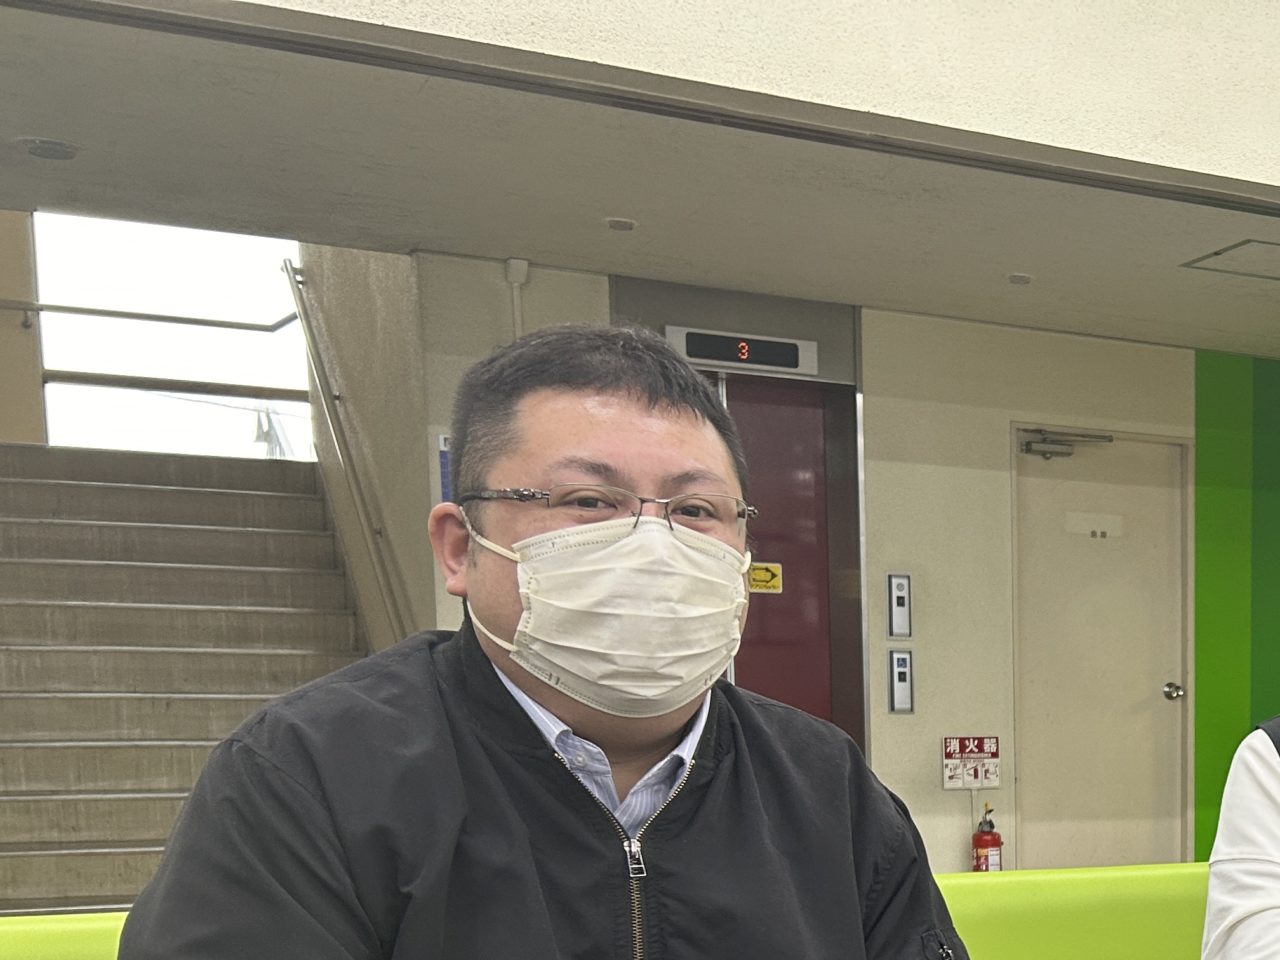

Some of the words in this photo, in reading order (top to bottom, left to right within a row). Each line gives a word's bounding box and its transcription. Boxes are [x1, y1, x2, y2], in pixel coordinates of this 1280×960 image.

[738, 341, 750, 360] 3
[946, 738, 998, 754] 消火器
